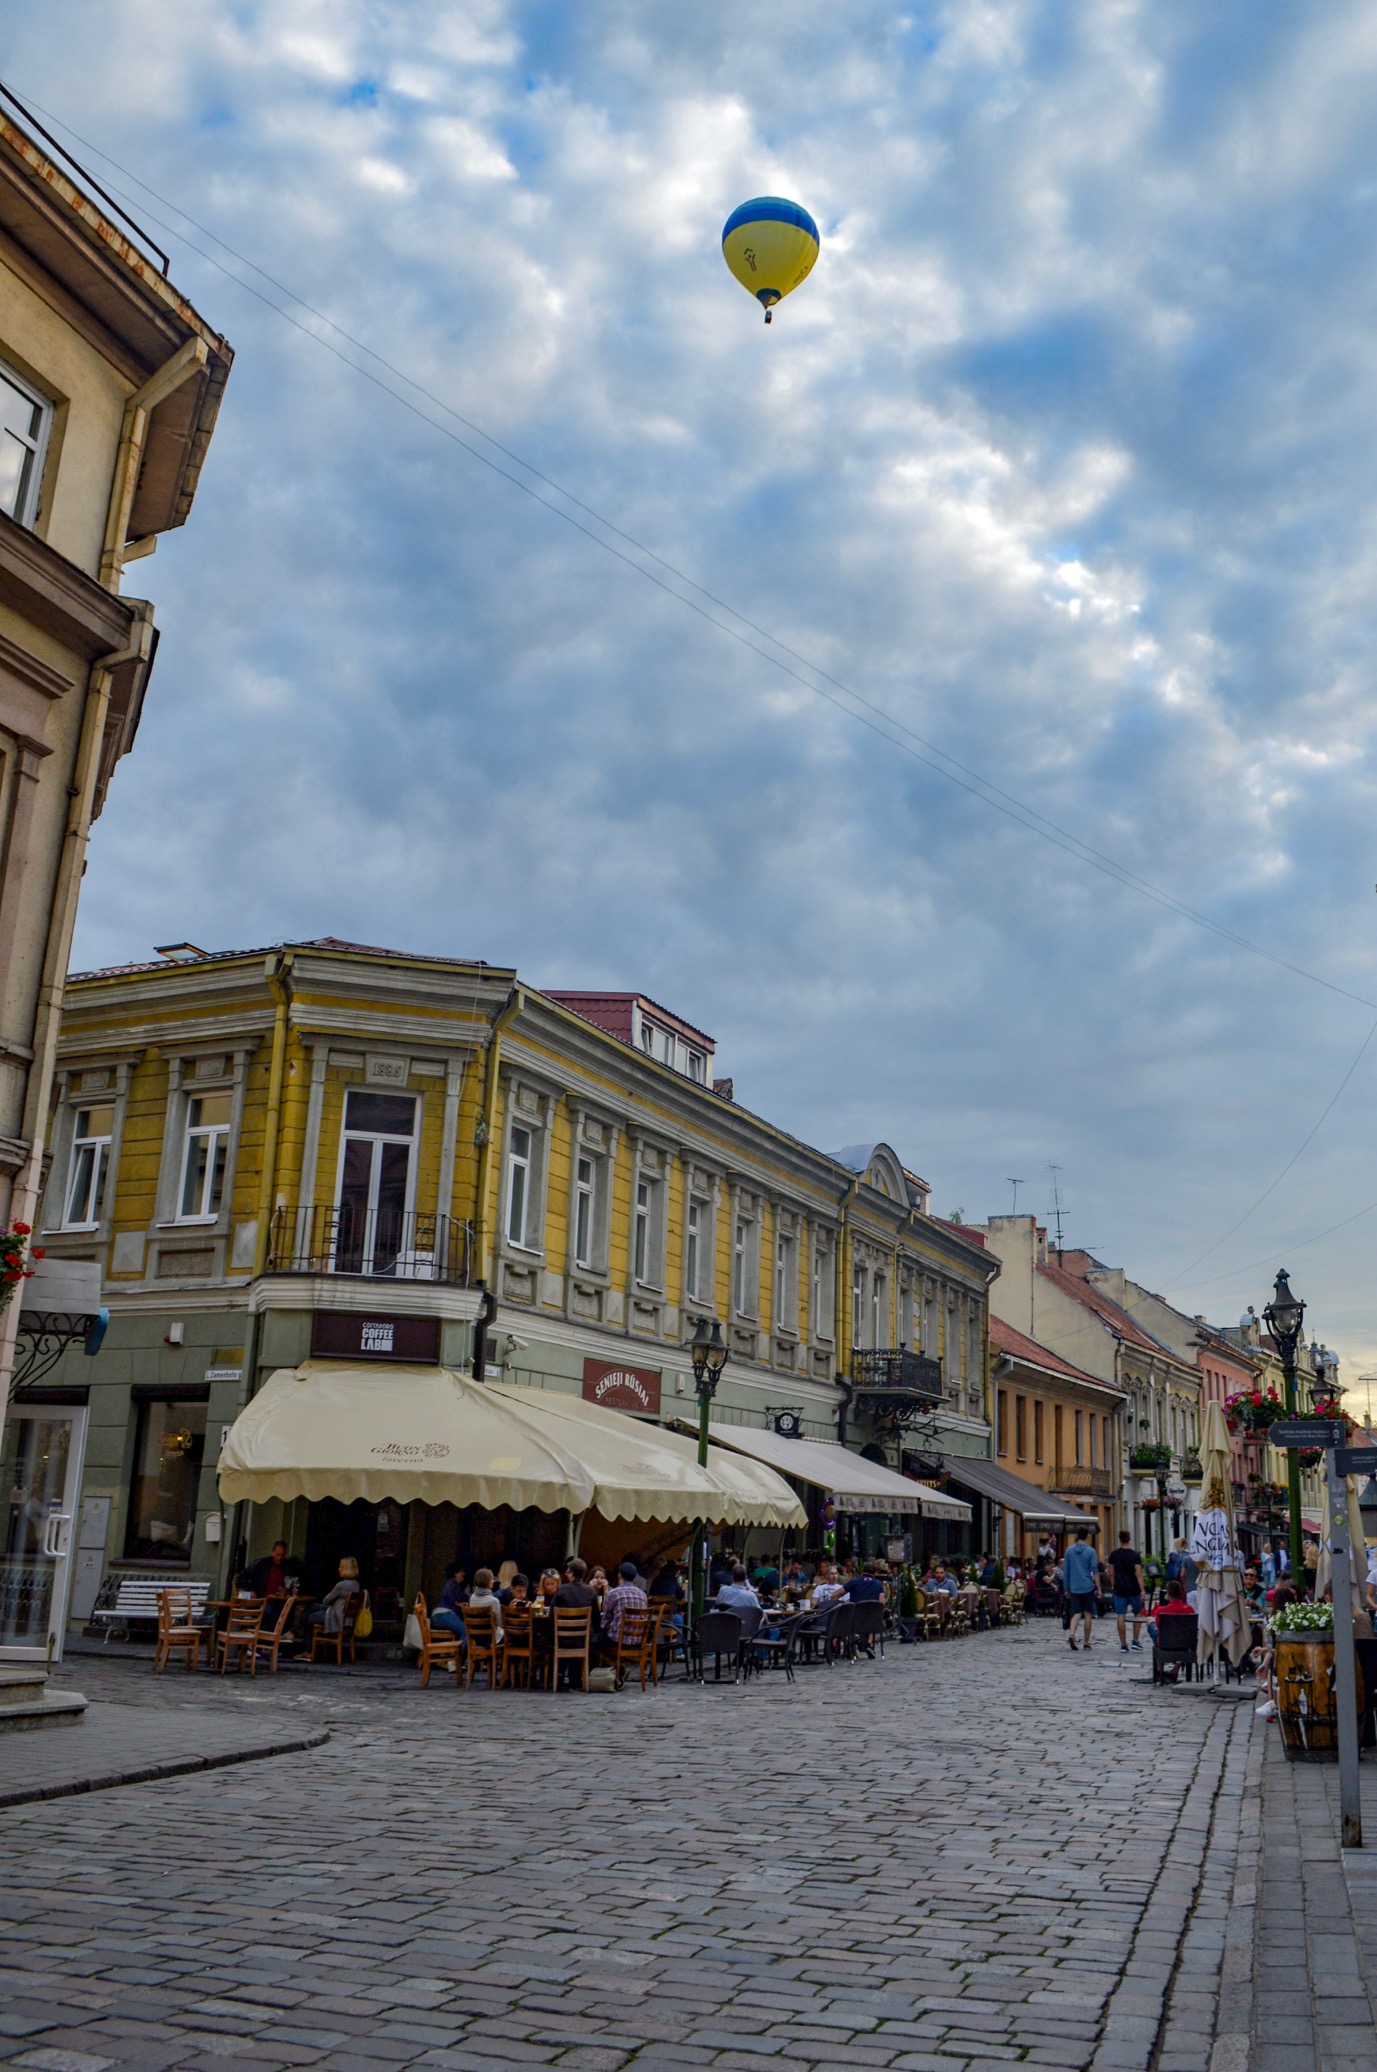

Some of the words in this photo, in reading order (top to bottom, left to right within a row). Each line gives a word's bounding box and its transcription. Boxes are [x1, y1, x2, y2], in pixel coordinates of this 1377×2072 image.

[362, 1328, 393, 1339] COFFEE
[361, 1338, 381, 1350] LAB
[595, 1372, 623, 1399] SENIEJI
